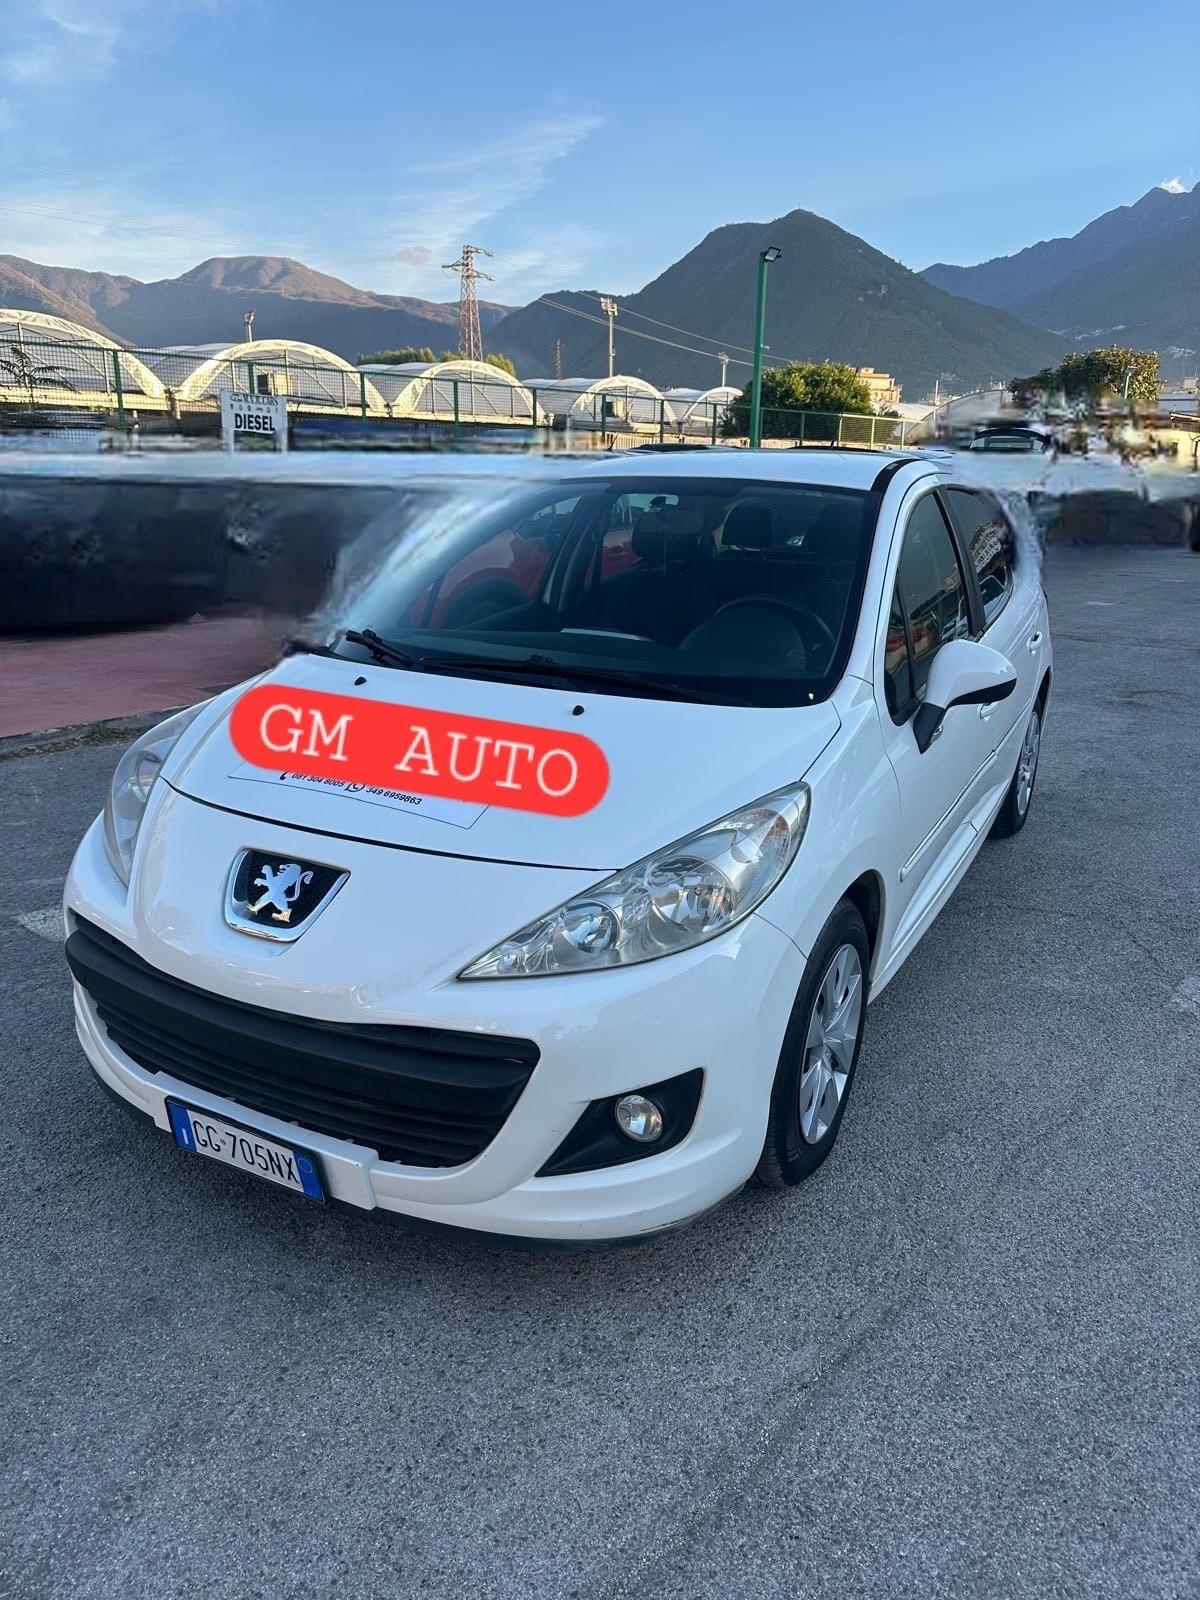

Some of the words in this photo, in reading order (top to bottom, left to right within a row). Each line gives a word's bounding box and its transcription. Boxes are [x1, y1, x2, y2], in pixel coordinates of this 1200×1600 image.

[234, 413, 276, 431] DIESEL
[308, 776, 322, 784] 304
[366, 787, 384, 796] 349
[384, 790, 423, 805] 6959863
